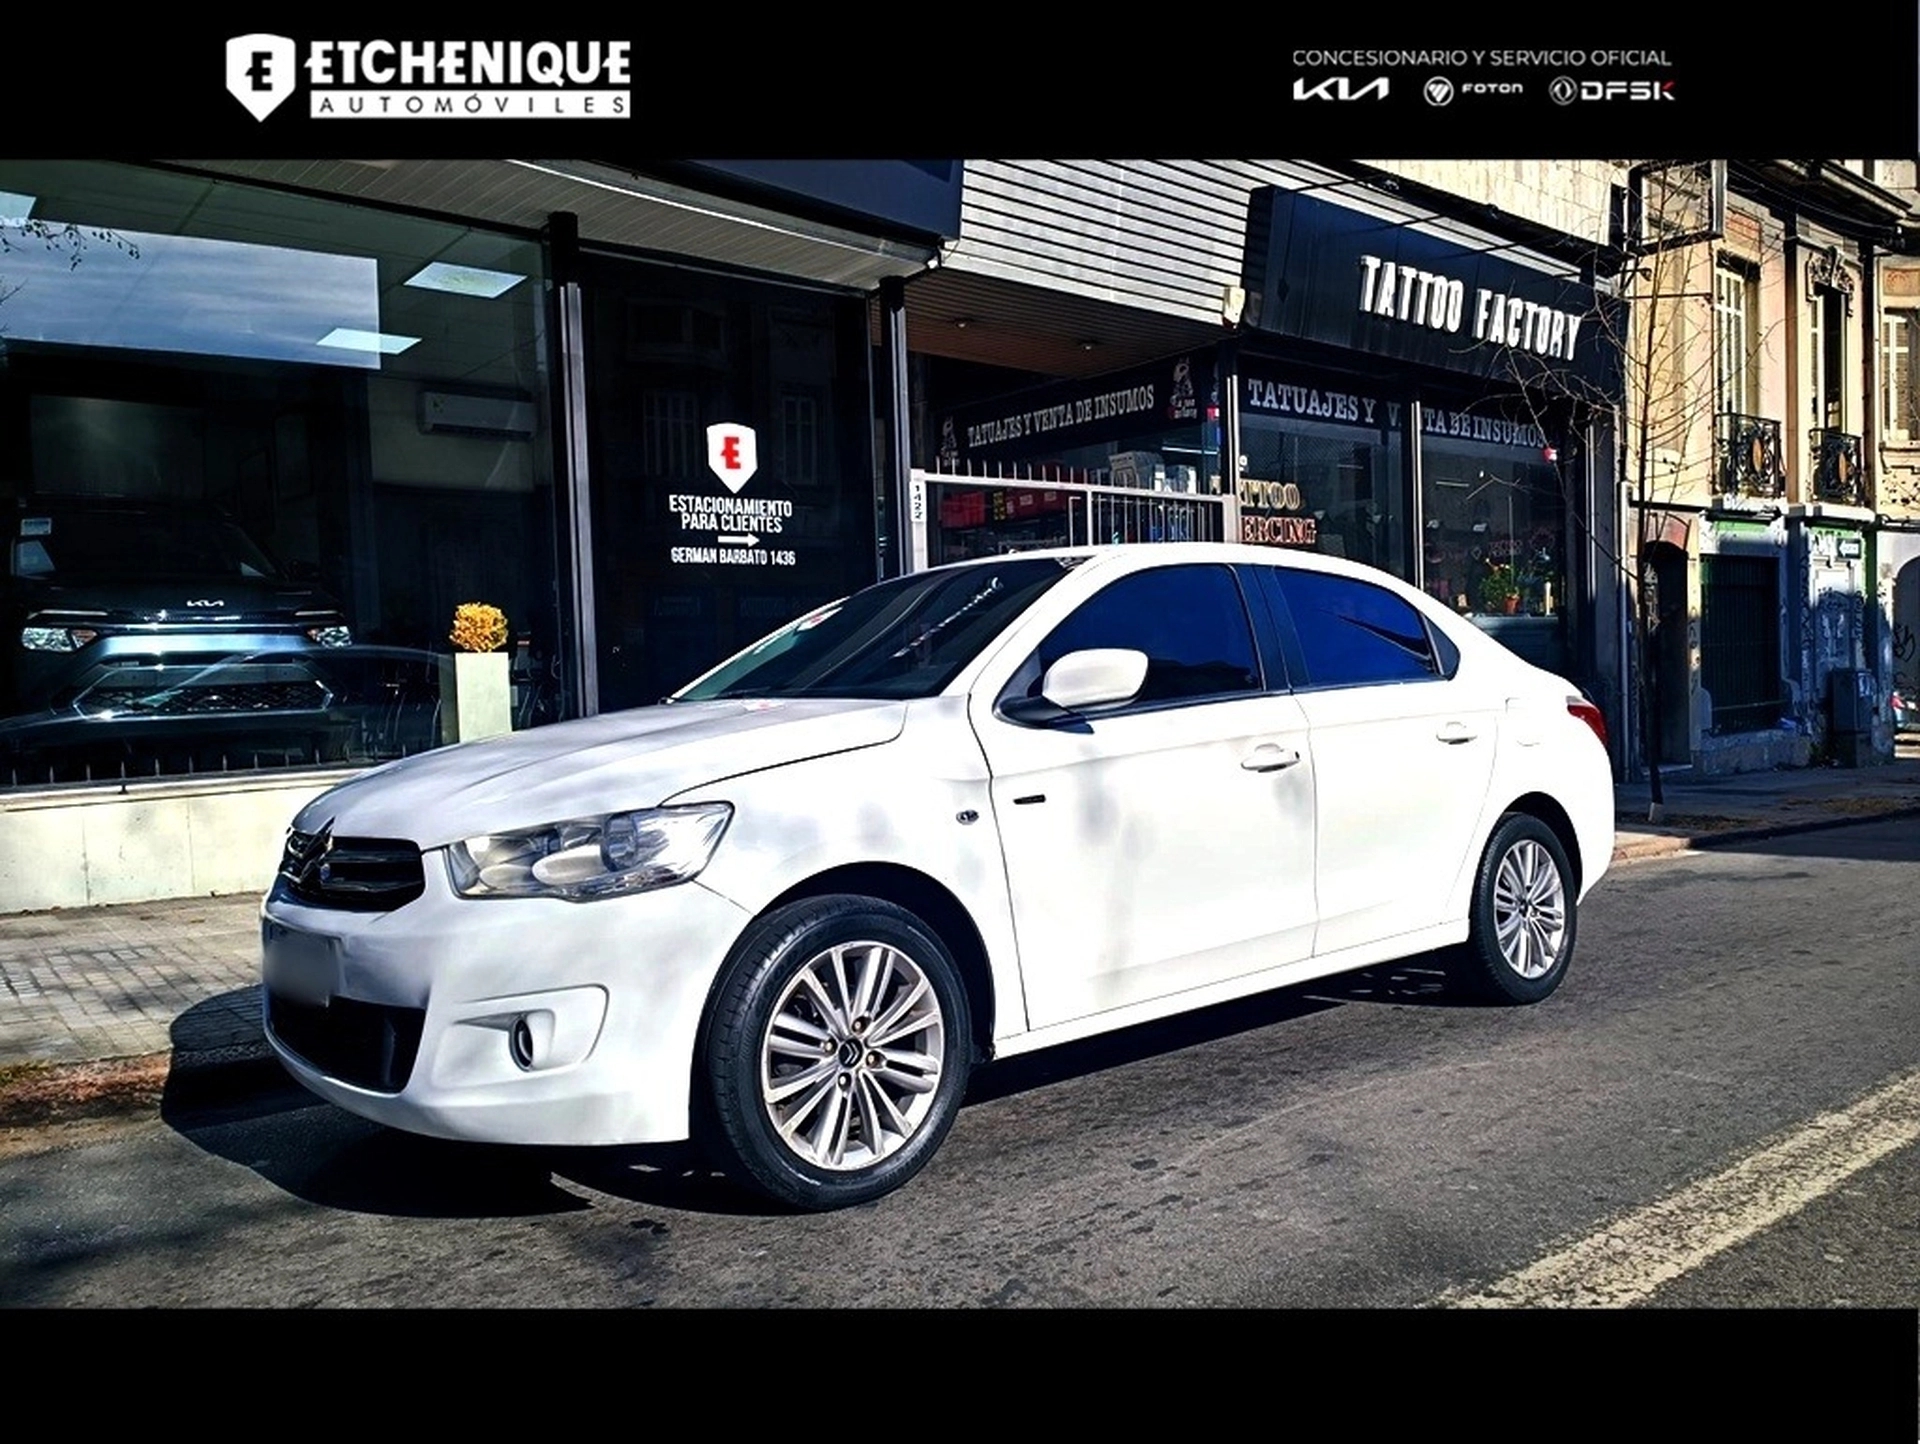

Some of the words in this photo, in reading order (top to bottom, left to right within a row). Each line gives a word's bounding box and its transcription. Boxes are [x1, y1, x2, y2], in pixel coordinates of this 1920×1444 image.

[1359, 255, 1464, 334] TATTOO
[1472, 287, 1582, 362] FACTORY
[968, 416, 1022, 448] TATUAJES
[1022, 411, 1033, 436] Y
[1033, 402, 1075, 433] VENTA
[1076, 398, 1093, 424] DE
[1094, 384, 1155, 420] INSUMOS
[1248, 378, 1359, 422] TATUAJES
[1361, 397, 1377, 424] Y
[669, 494, 793, 518] ESTACIONAMIENTO
[1239, 478, 1301, 511] TTOO
[681, 512, 719, 531] PARA
[720, 514, 783, 534] CLIENTES
[1241, 515, 1317, 545] ERCING
[671, 546, 717, 564] GERMAN
[719, 548, 768, 565] BARBATO
[770, 550, 796, 566] 1436
